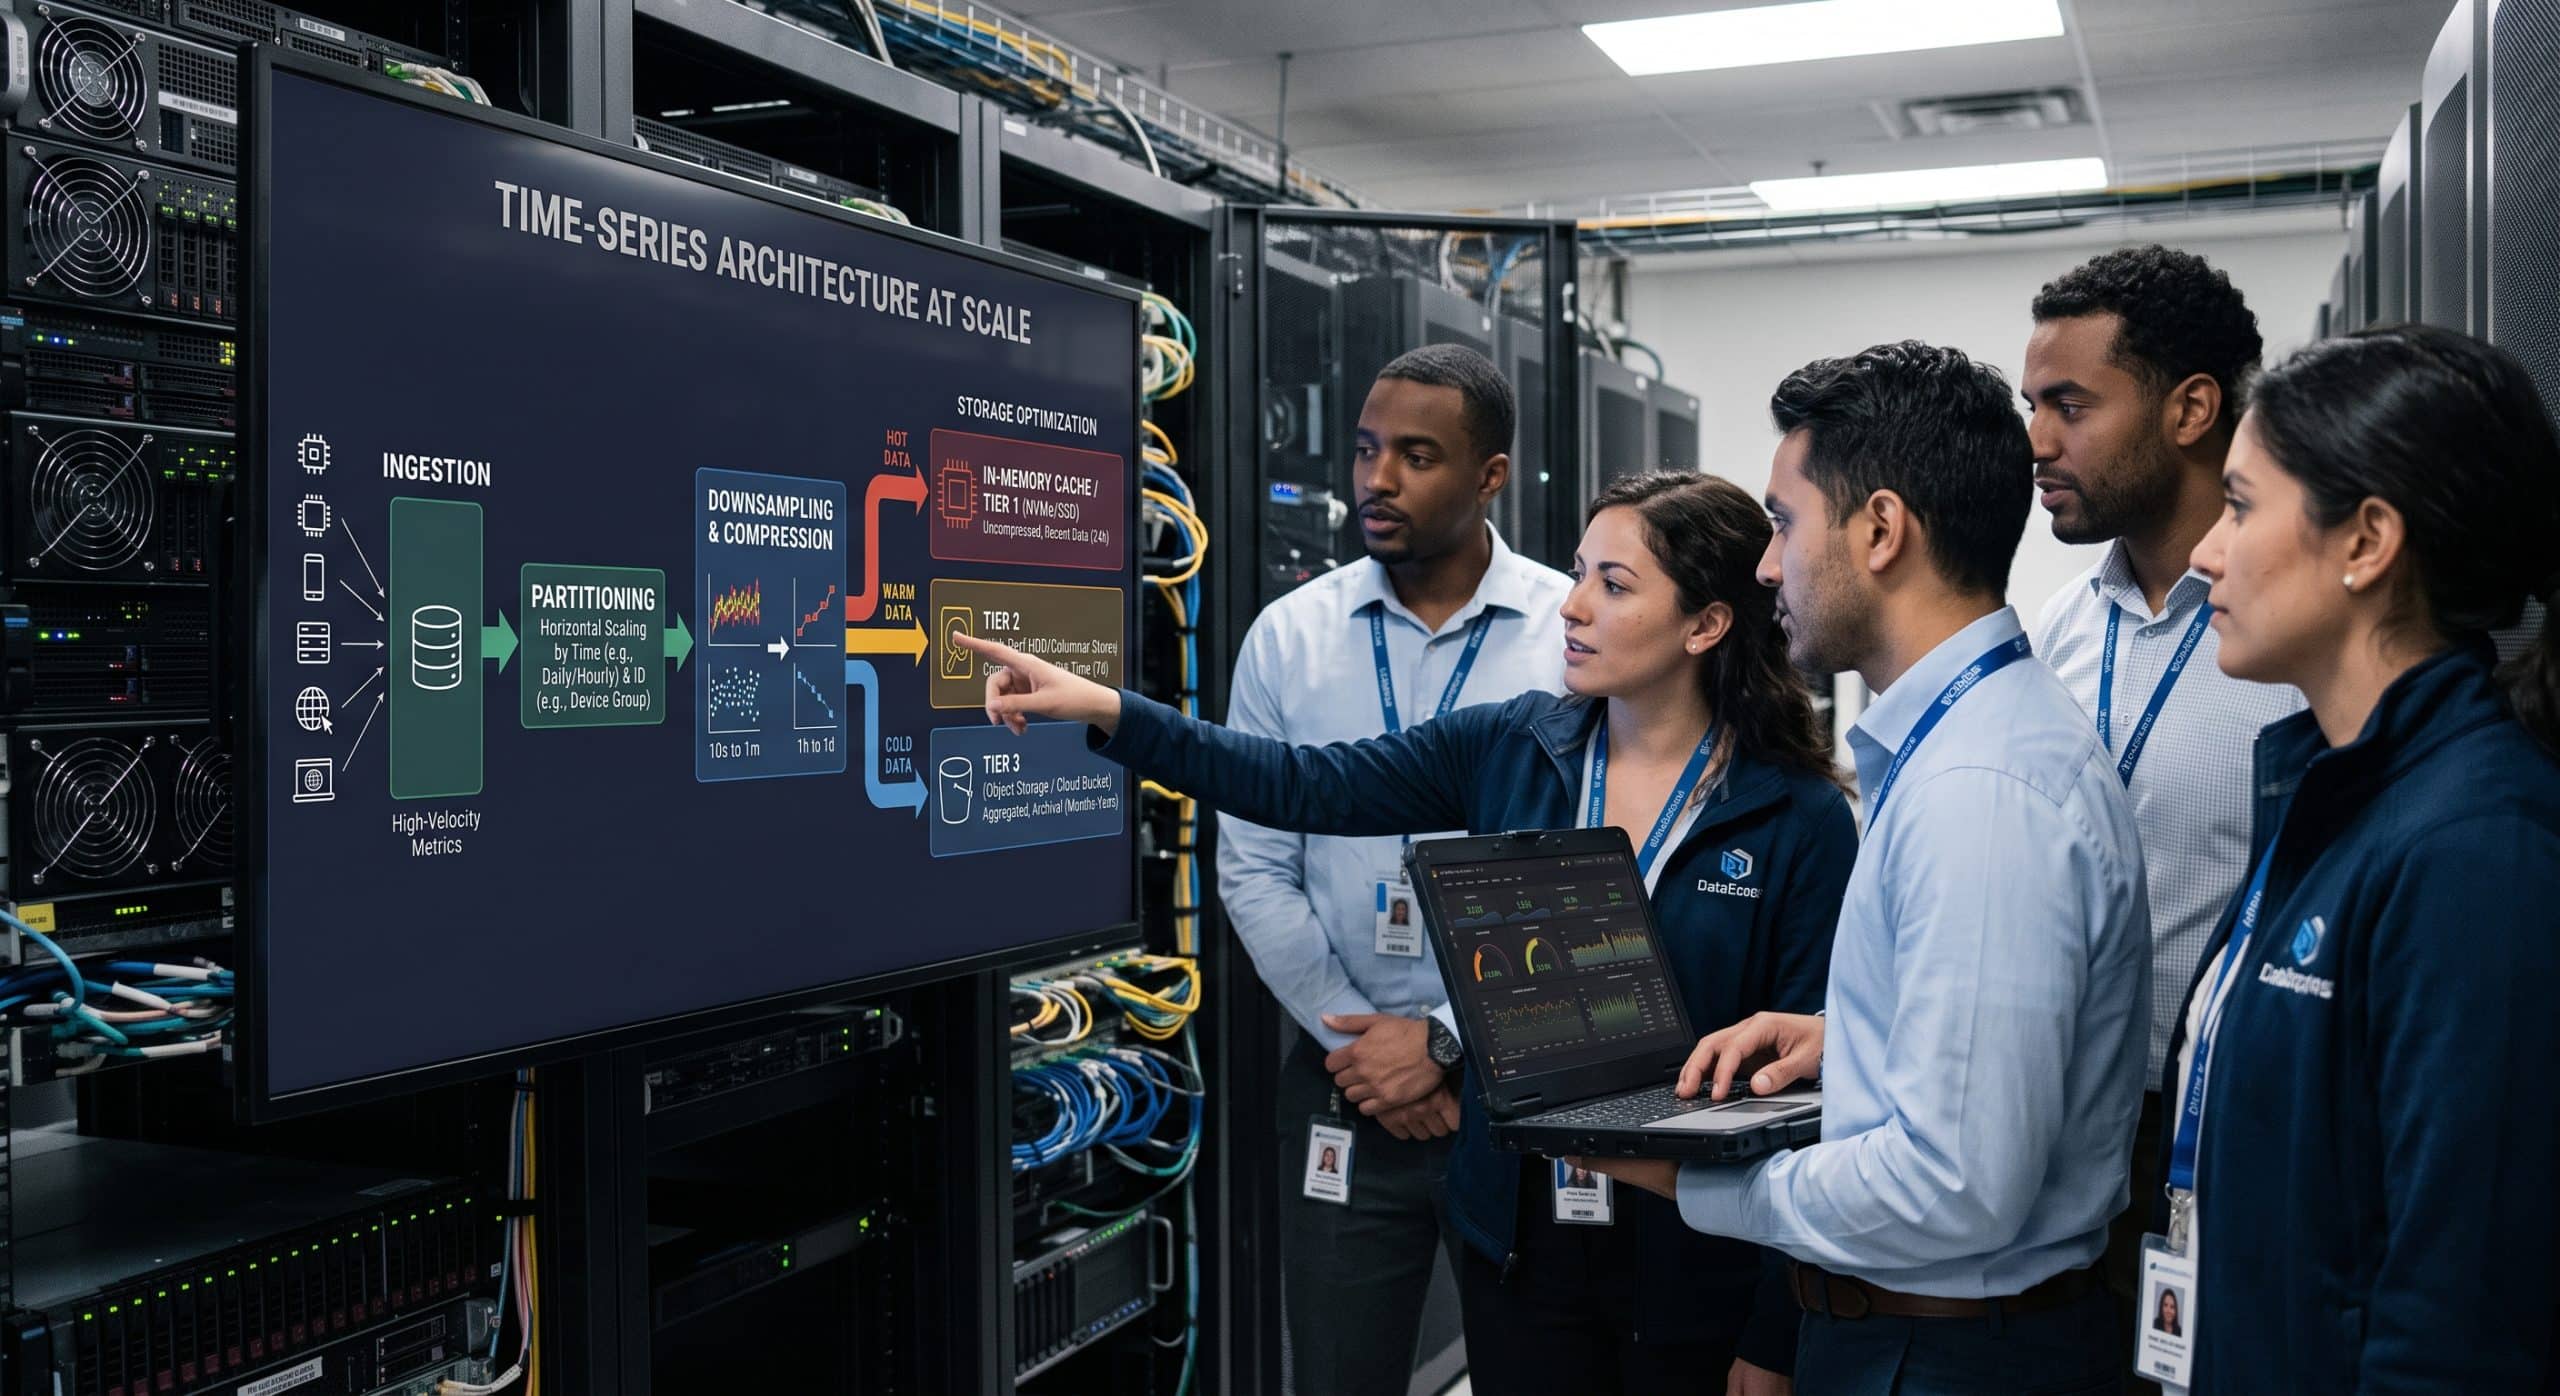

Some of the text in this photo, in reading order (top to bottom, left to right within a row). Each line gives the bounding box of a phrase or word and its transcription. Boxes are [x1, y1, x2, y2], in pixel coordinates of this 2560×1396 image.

[495, 180, 1031, 344] TIME-SERIES ARCHITECTURE AT SCALE
[957, 396, 1097, 436] STORAGE OPTIMIZATION
[886, 430, 908, 447] HOT
[383, 452, 491, 487] INGESTION
[884, 450, 911, 469] DATA
[983, 465, 1051, 493] IN-MEMORY
[1054, 474, 1092, 496] CACHE
[708, 488, 833, 521] DOWNSAMPLING
[983, 493, 1080, 523] TIER 1 (NVMe/SSD)
[708, 520, 833, 550] & COMPRESSION
[983, 520, 1110, 546] Uncompressed, Recent Data (24h)
[531, 584, 655, 611] PARTITIONING
[883, 584, 915, 600] WARM
[885, 605, 912, 621] DATA
[983, 611, 1020, 631] TIER 2
[540, 618, 647, 641] Horizontal Scaling
[554, 641, 633, 665] by Time (e.g.,
[1028, 638, 1090, 655] HDD/Columnar
[542, 666, 646, 689] Daily/Hourly) & ID
[1072, 661, 1091, 676] Time
[537, 689, 651, 714] (e.g., Device Group)
[709, 741, 760, 759] 10s to 1m
[798, 736, 835, 754] 1h to 1d
[885, 736, 912, 752] COLD
[885, 757, 912, 774] DATA
[983, 754, 1020, 774] TIER 3
[982, 781, 1014, 801] (Object
[1016, 780, 1049, 798] Storage
[1056, 775, 1081, 792] Cloud
[1082, 772, 1112, 791] Bucket)
[392, 809, 480, 836] High-Velocity
[982, 804, 1030, 824] Aggregated,
[1032, 800, 1063, 816] Archival
[412, 836, 462, 856] Metrics
